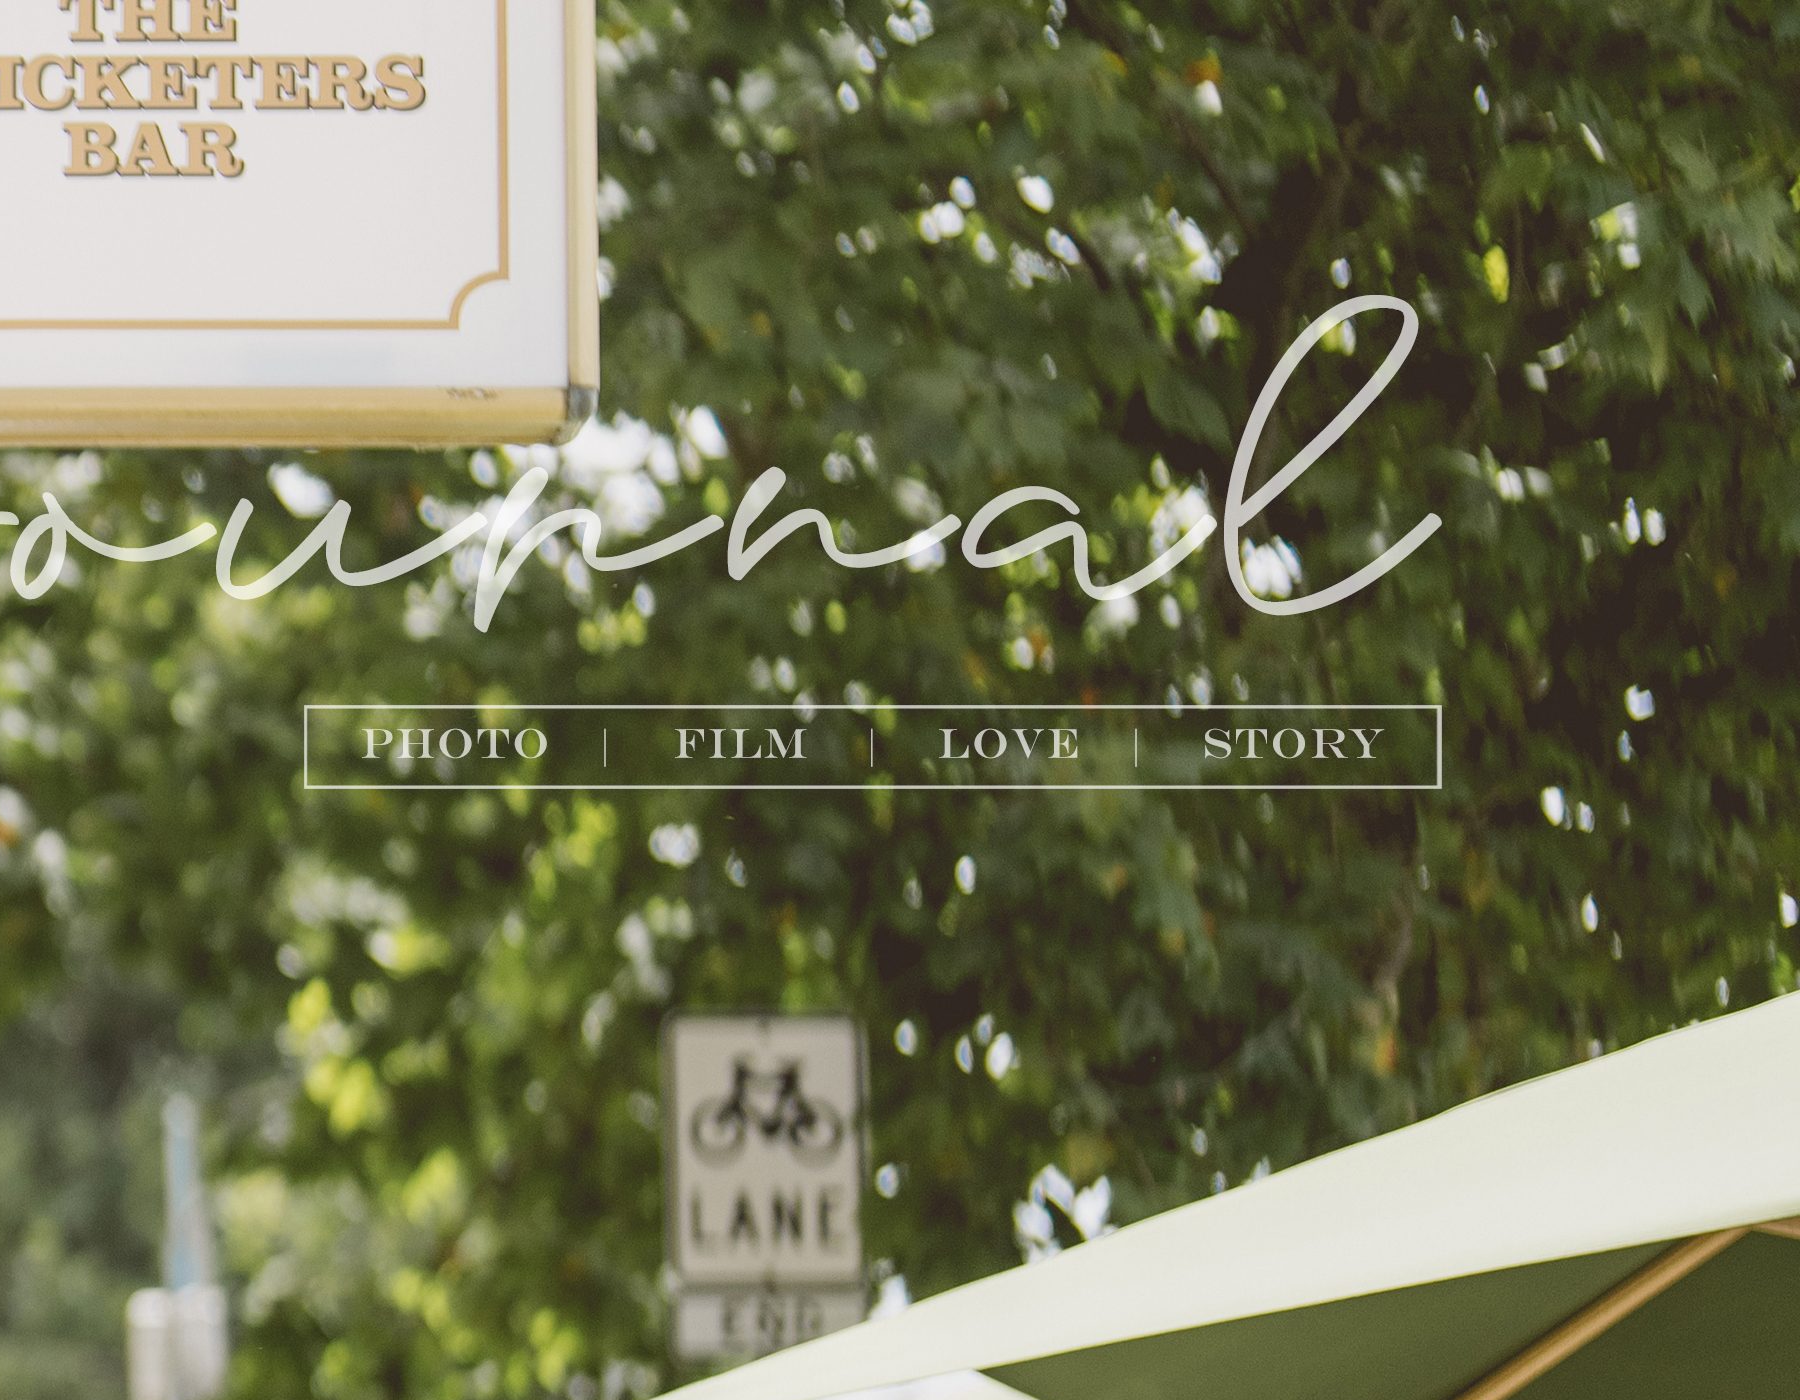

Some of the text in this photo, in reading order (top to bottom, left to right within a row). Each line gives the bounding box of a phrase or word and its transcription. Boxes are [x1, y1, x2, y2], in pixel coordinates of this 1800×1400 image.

[60, 0, 239, 43] THE
[61, 121, 245, 178] BAR
[689, 1187, 843, 1252] LANE
